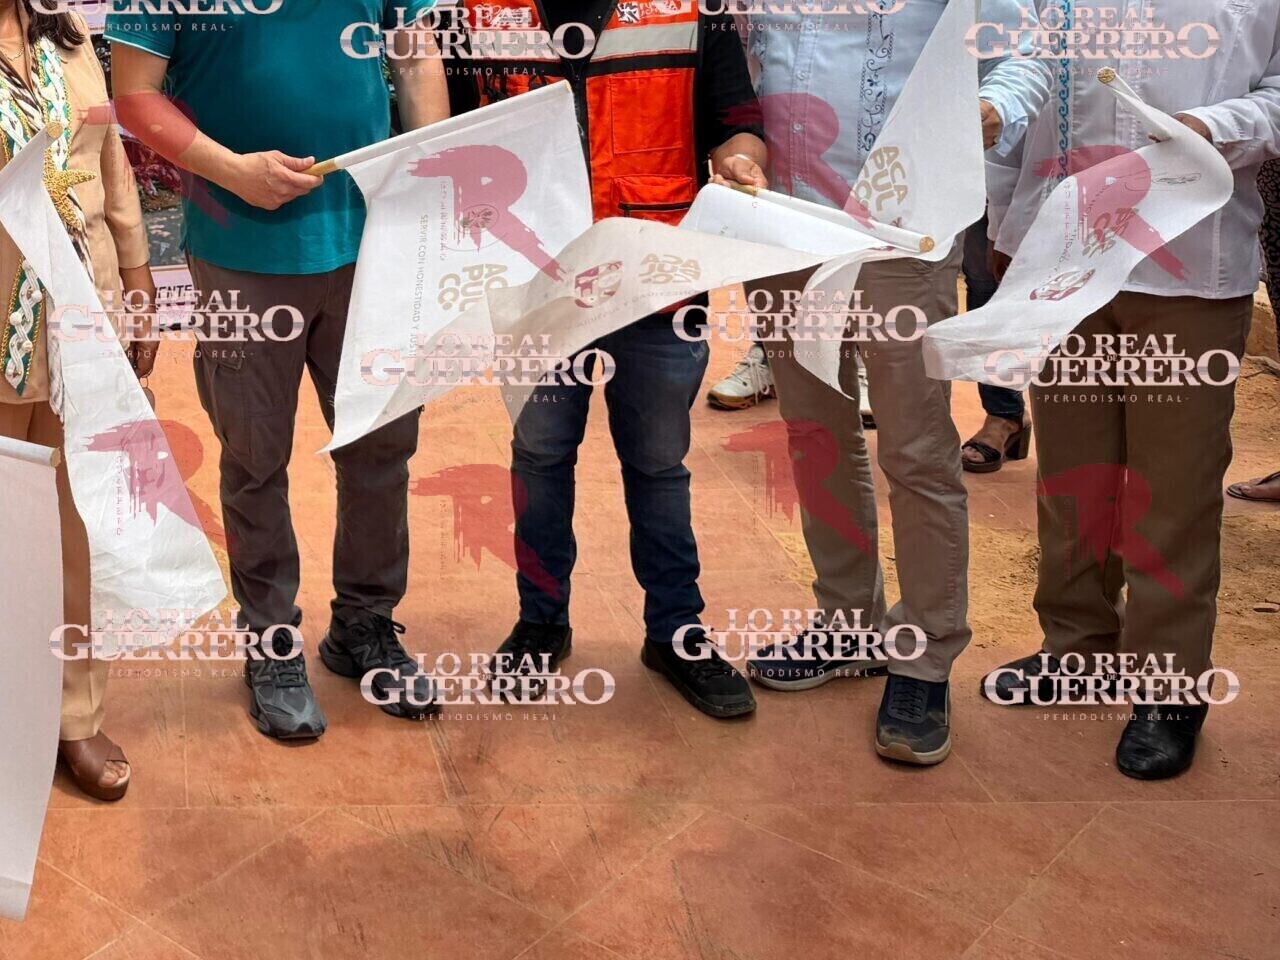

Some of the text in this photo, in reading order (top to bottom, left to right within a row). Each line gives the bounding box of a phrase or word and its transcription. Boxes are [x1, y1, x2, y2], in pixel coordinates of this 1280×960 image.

[418, 214, 429, 243] SERVIR
[417, 245, 427, 264] CON
[412, 265, 425, 323] HONESTIDAD
